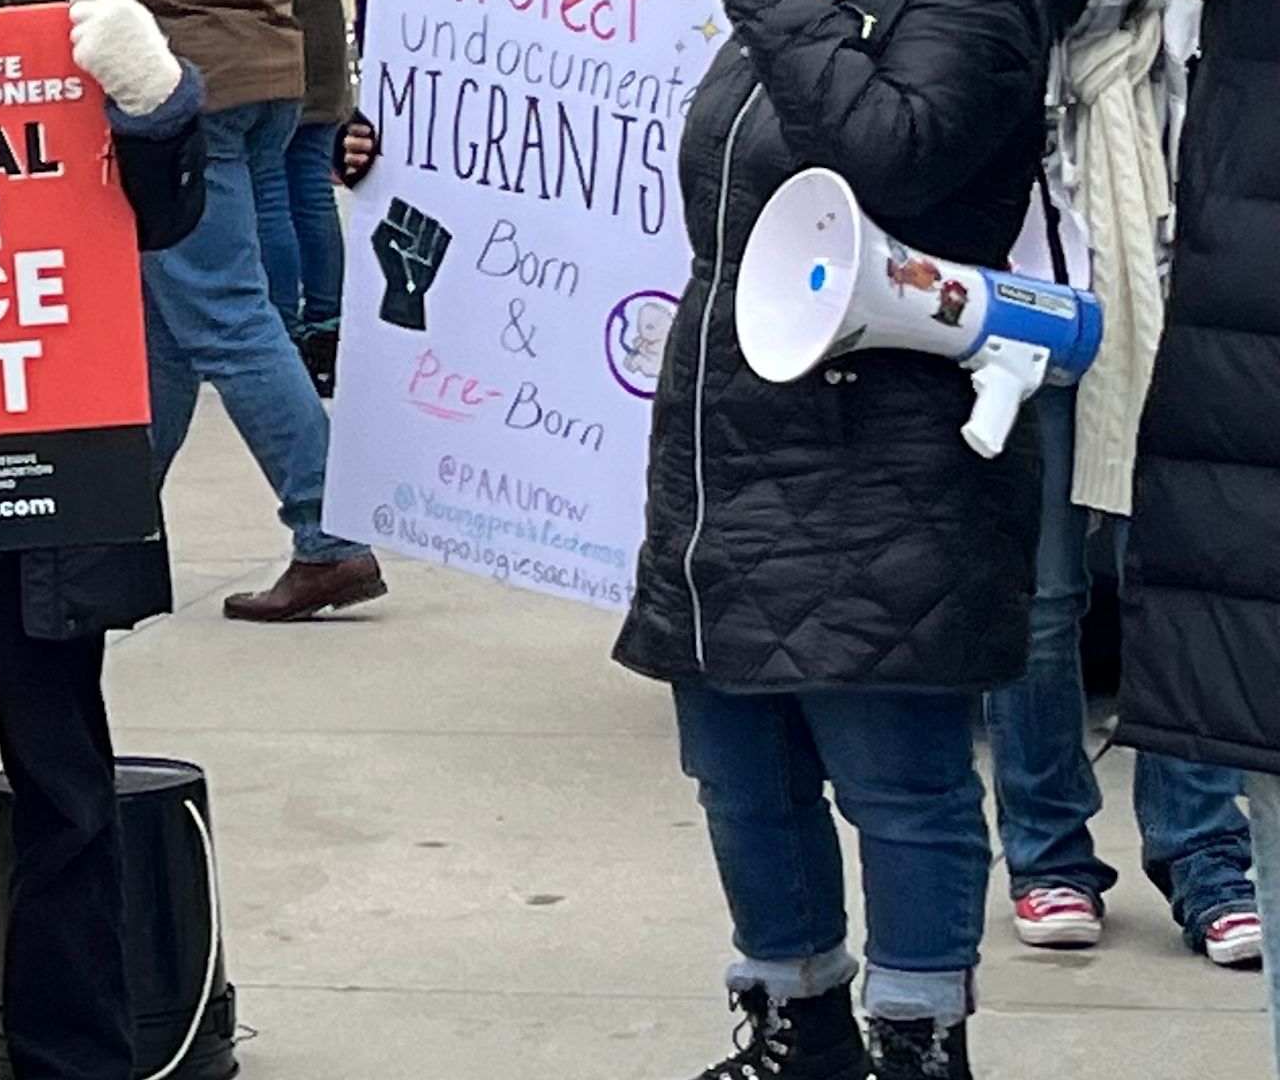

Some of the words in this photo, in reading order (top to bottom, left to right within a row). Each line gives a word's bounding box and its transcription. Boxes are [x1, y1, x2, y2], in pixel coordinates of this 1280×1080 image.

[402, 13, 698, 119] undocumente
[377, 62, 666, 235] MIGRANTS
[476, 219, 579, 296] Born
[500, 298, 537, 358] &
